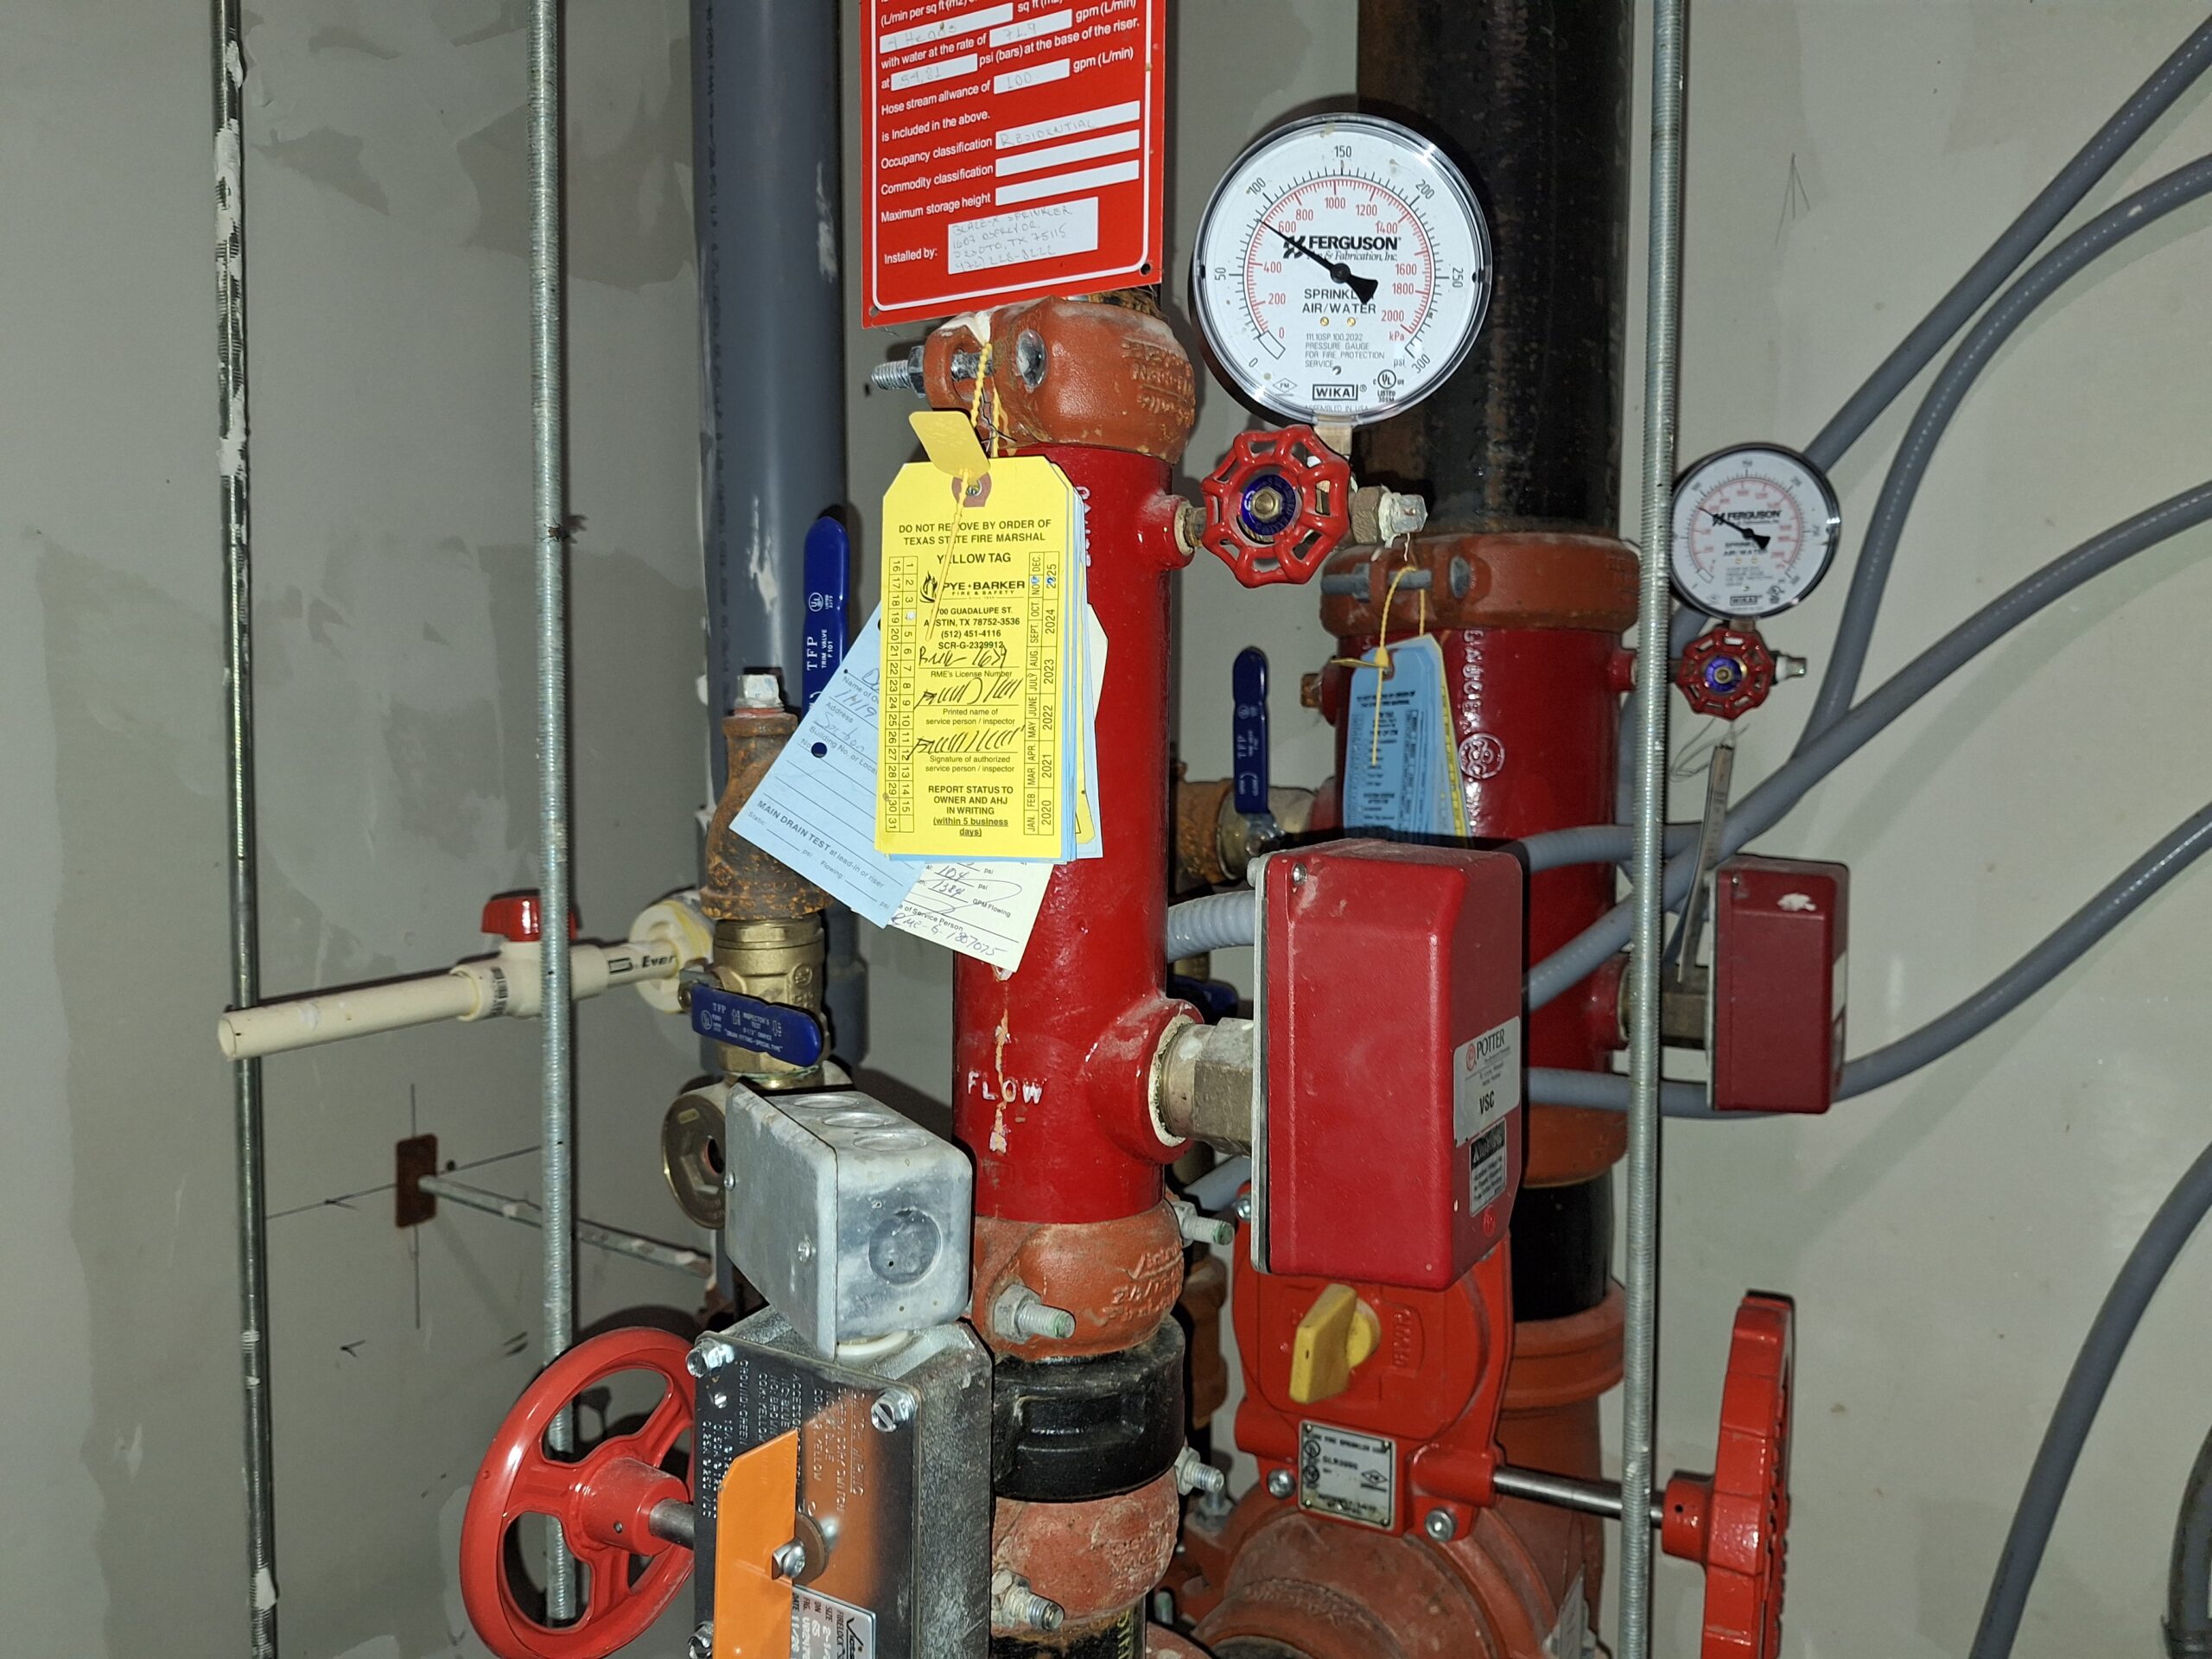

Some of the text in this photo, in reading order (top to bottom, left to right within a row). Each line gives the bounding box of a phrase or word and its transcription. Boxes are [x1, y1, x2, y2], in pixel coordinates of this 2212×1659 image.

[880, 5, 937, 28] (L/min per sq
[1017, 3, 1030, 13] sq
[1076, 7, 1099, 23] gpm
[881, 33, 988, 69] with water at the rate of
[979, 17, 1140, 68] psi (bars) at the base of the riser.
[1073, 46, 1134, 73] gpm (L/min)
[881, 79, 890, 89] at
[881, 79, 991, 116] Hose stream allwance of
[881, 110, 991, 143] is Included in the above.
[880, 137, 993, 169] Occupancy classification
[1334, 145, 1352, 158] 150
[880, 165, 994, 195] Commodity classification
[1249, 177, 1267, 195] 100
[1415, 179, 1435, 200] 200
[880, 192, 991, 223] Maximum storage height
[1325, 197, 1346, 209] 1000
[1356, 204, 1377, 216] 1200
[1295, 209, 1314, 221] 800
[1278, 220, 1297, 233] 600
[1376, 220, 1398, 234] 1400
[1309, 236, 1398, 251] FERGUSON
[884, 247, 938, 264] Installed by:
[1215, 267, 1226, 281] 50
[1263, 262, 1283, 273] 400
[1395, 264, 1417, 276] 1600
[1452, 267, 1464, 289] 250
[1392, 283, 1414, 295] 1800
[1268, 293, 1287, 305] 200
[1382, 310, 1404, 321] 2000
[1389, 332, 1405, 341] kPa
[1394, 358, 1405, 367] psi
[1411, 353, 1431, 374] 300
[1728, 510, 1782, 519] FERGUSON
[899, 519, 1052, 533] DO NOT BY ORDER OF
[904, 532, 1046, 545] TEXAS FIRE MARSHAL
[937, 552, 1011, 564] YLLOW TAG
[1032, 554, 1041, 572] DEC.
[973, 580, 1026, 590] BARKER
[1045, 609, 1056, 634] 2024
[1044, 658, 1054, 684] 2023
[842, 677, 862, 692] Name
[1029, 673, 1038, 690] JULY
[826, 702, 854, 723] Address
[1028, 697, 1038, 716] JUNE
[983, 717, 1015, 726] inspector
[1042, 705, 1053, 731] 2022
[809, 727, 837, 749] Building
[1028, 721, 1037, 738] MAY
[1042, 753, 1052, 778] 2021
[966, 785, 999, 794] STATUS
[946, 806, 995, 815] IN WRITING
[1041, 799, 1052, 825] 2020
[757, 801, 830, 851] MAIN DRAIN TEST
[933, 817, 961, 826] (within
[970, 817, 1008, 826] business
[959, 828, 982, 837] days)
[973, 899, 1012, 918] GPM Flowing
[912, 908, 963, 931] Service Person
[1476, 1028, 1504, 1060] POTTER
[968, 1071, 1043, 1104] FLOW
[1479, 1090, 1495, 1115] VSC
